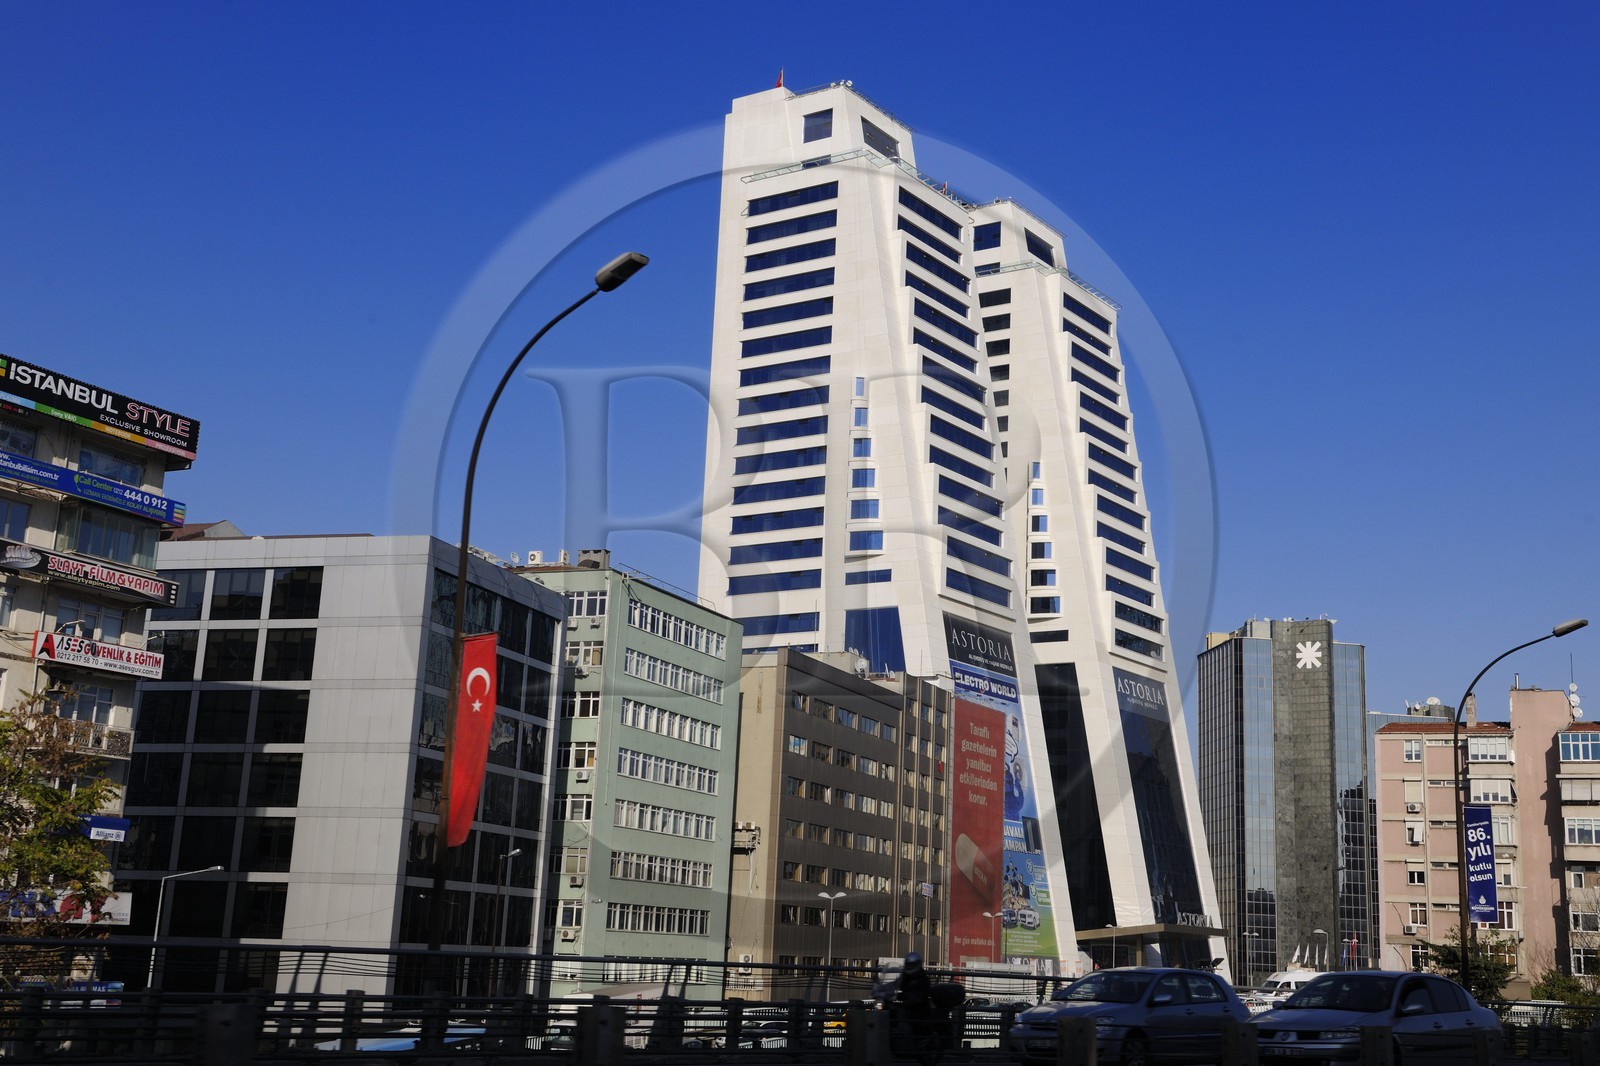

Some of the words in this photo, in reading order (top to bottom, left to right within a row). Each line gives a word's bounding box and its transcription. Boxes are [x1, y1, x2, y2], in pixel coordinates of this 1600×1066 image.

[126, 402, 190, 437] STYLE
[100, 414, 140, 432] EXCLUSIVE
[143, 428, 187, 447] SHOWROOM
[79, 475, 91, 485] Call
[92, 479, 113, 491] Center
[124, 489, 142, 502] 444
[143, 496, 150, 505] 0
[151, 498, 168, 509] 912
[48, 556, 87, 576] SLAYT
[47, 570, 121, 592] www.slaytyapim.com
[952, 628, 1012, 662] ASTORIA
[57, 652, 71, 660] 0212
[92, 658, 99, 666] 70
[103, 661, 160, 677] www.asesguv.com.tr
[126, 652, 133, 663] &
[134, 651, 161, 668] EĞİTİM
[955, 672, 989, 691] ELECTRO
[990, 682, 1016, 698] WORLD
[1117, 676, 1165, 706] ASTORIA
[969, 722, 990, 739] Taraflı
[961, 739, 997, 758] gazetelerin
[960, 772, 998, 791] etkilerinden
[969, 790, 987, 806] korur.
[95, 830, 114, 839] Allianz
[1467, 827, 1491, 842] 86.
[1467, 842, 1492, 861] yılı
[1468, 862, 1492, 872] kutlu
[1469, 873, 1493, 882] olsun
[1177, 911, 1214, 928] ASTORIA
